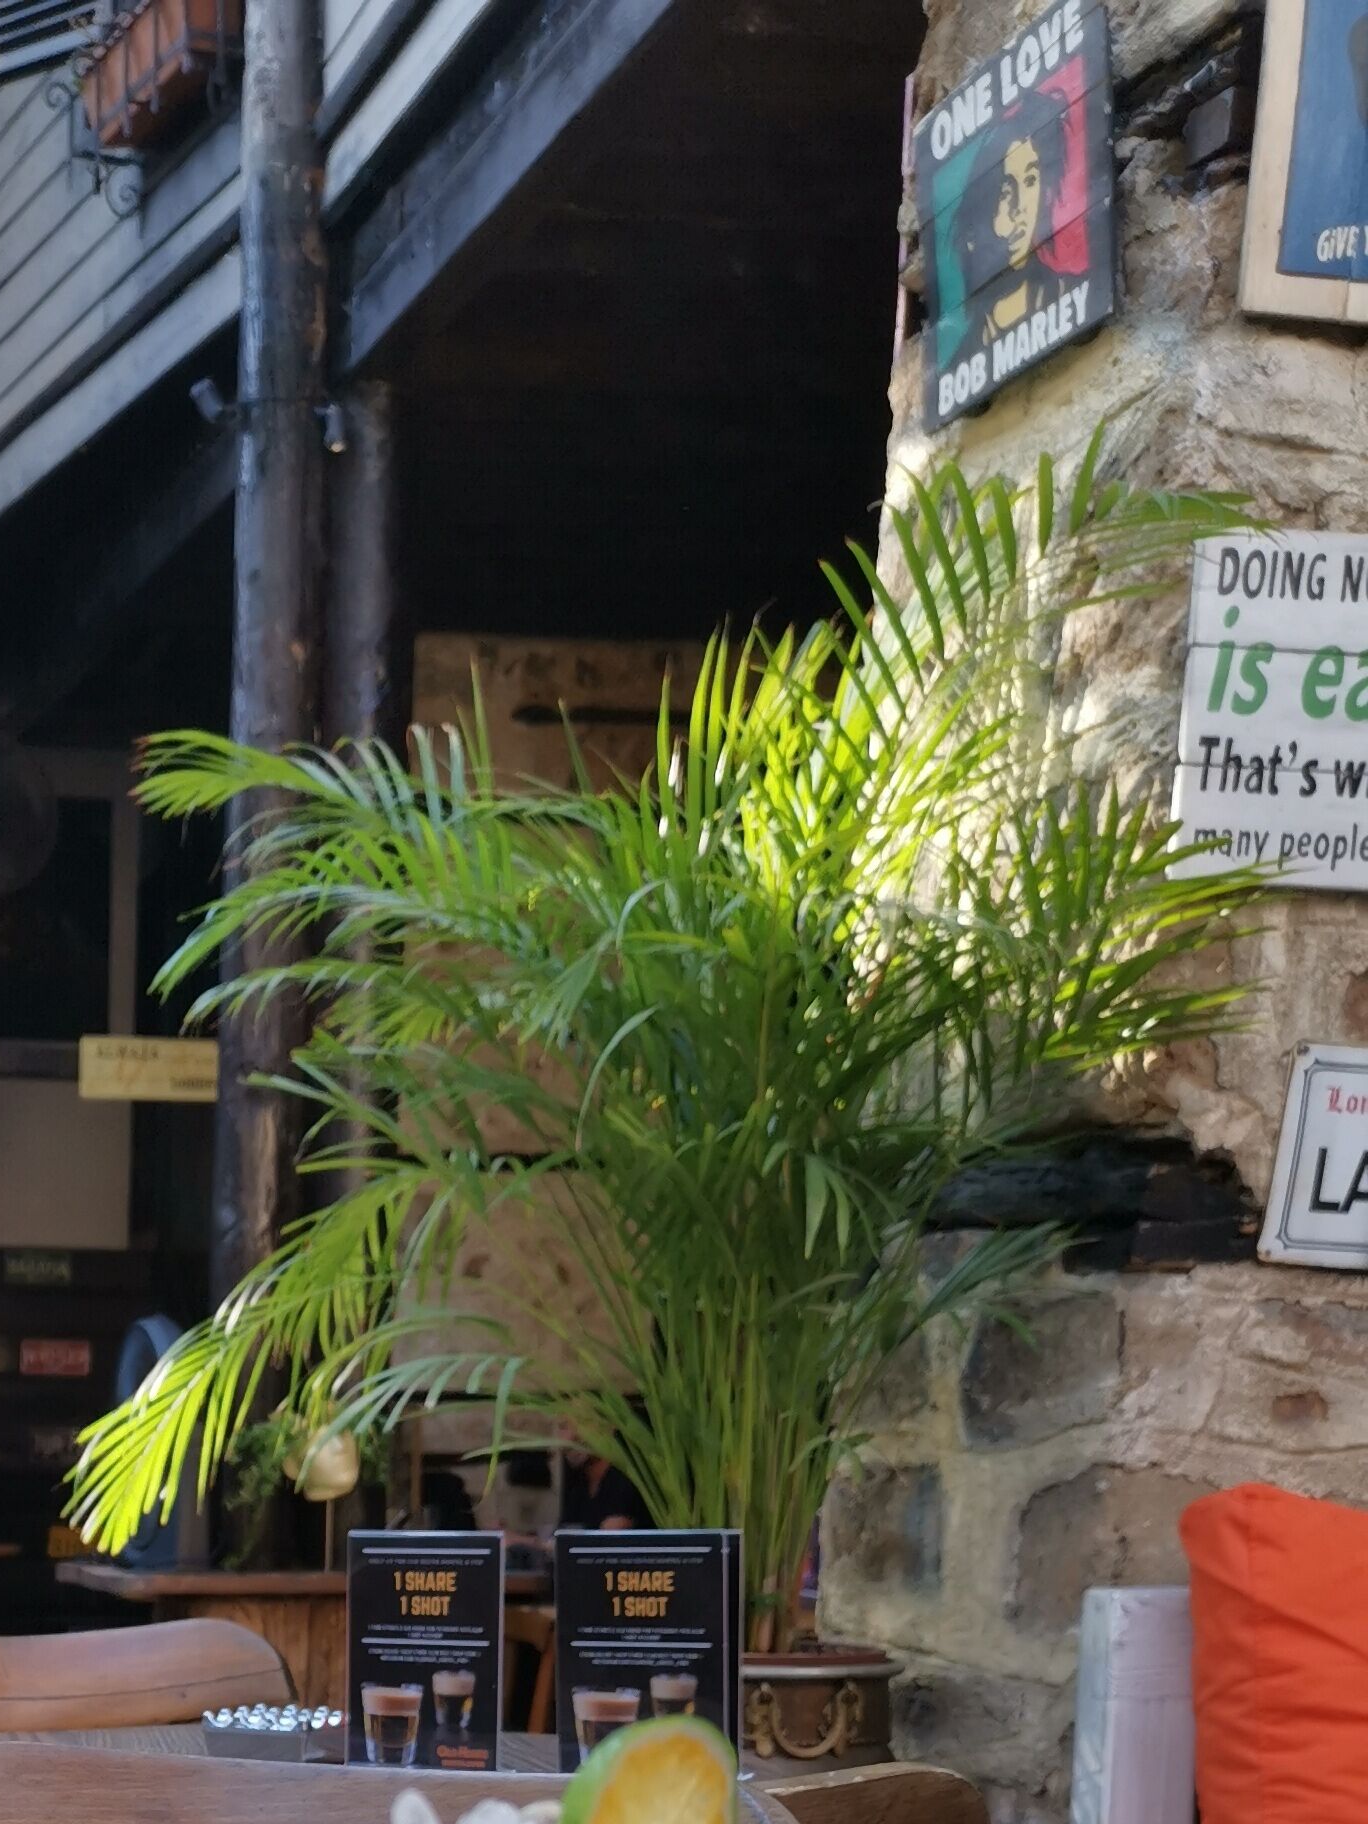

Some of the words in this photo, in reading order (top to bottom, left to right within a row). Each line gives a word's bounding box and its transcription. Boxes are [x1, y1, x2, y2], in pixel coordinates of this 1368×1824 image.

[931, 72, 994, 160] ONE
[1000, 0, 1084, 106] LOVE
[938, 352, 987, 416] BOB
[992, 280, 1090, 382] MARLEY
[1217, 546, 1327, 601] DOING
[1340, 554, 1368, 603] N
[1207, 605, 1275, 716] is
[1301, 644, 1368, 722] ea
[1198, 736, 1319, 798] That's
[1334, 759, 1368, 799] w
[1194, 828, 1270, 865] many
[1278, 822, 1368, 872] people
[393, 1571, 403, 1591] 1
[405, 1571, 458, 1592] SHARE
[400, 1595, 408, 1616] 1
[411, 1595, 451, 1616] SHOT
[605, 1571, 614, 1592] 1
[617, 1571, 676, 1592] SHARE
[612, 1596, 621, 1617] 1
[624, 1596, 669, 1617] SHOT
